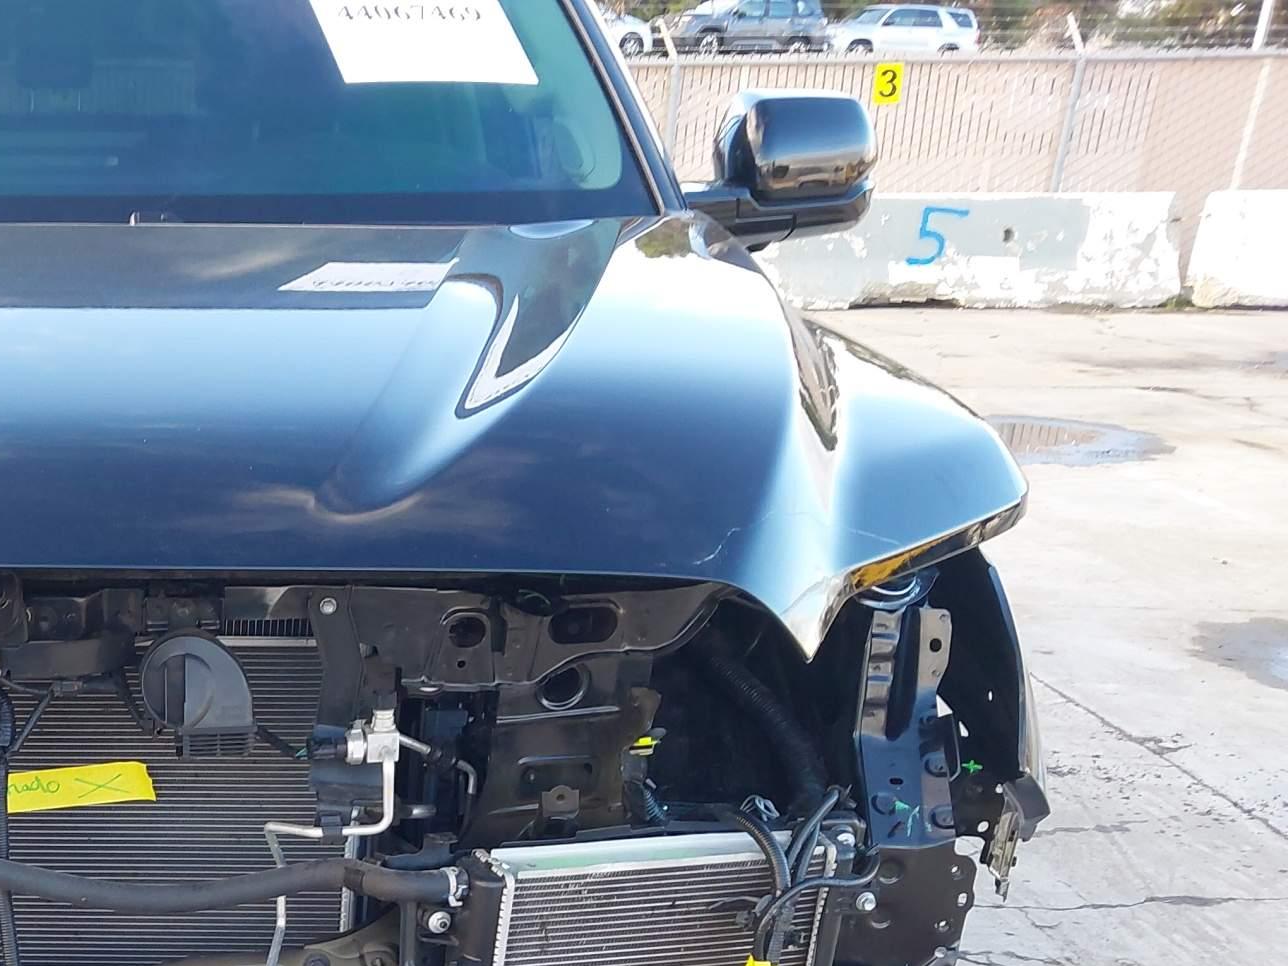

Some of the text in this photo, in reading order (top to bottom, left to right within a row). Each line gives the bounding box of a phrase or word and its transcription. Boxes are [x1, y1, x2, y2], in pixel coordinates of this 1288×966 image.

[338, 5, 481, 21] 44067469
[879, 69, 898, 97] 3
[906, 206, 970, 265] 5
